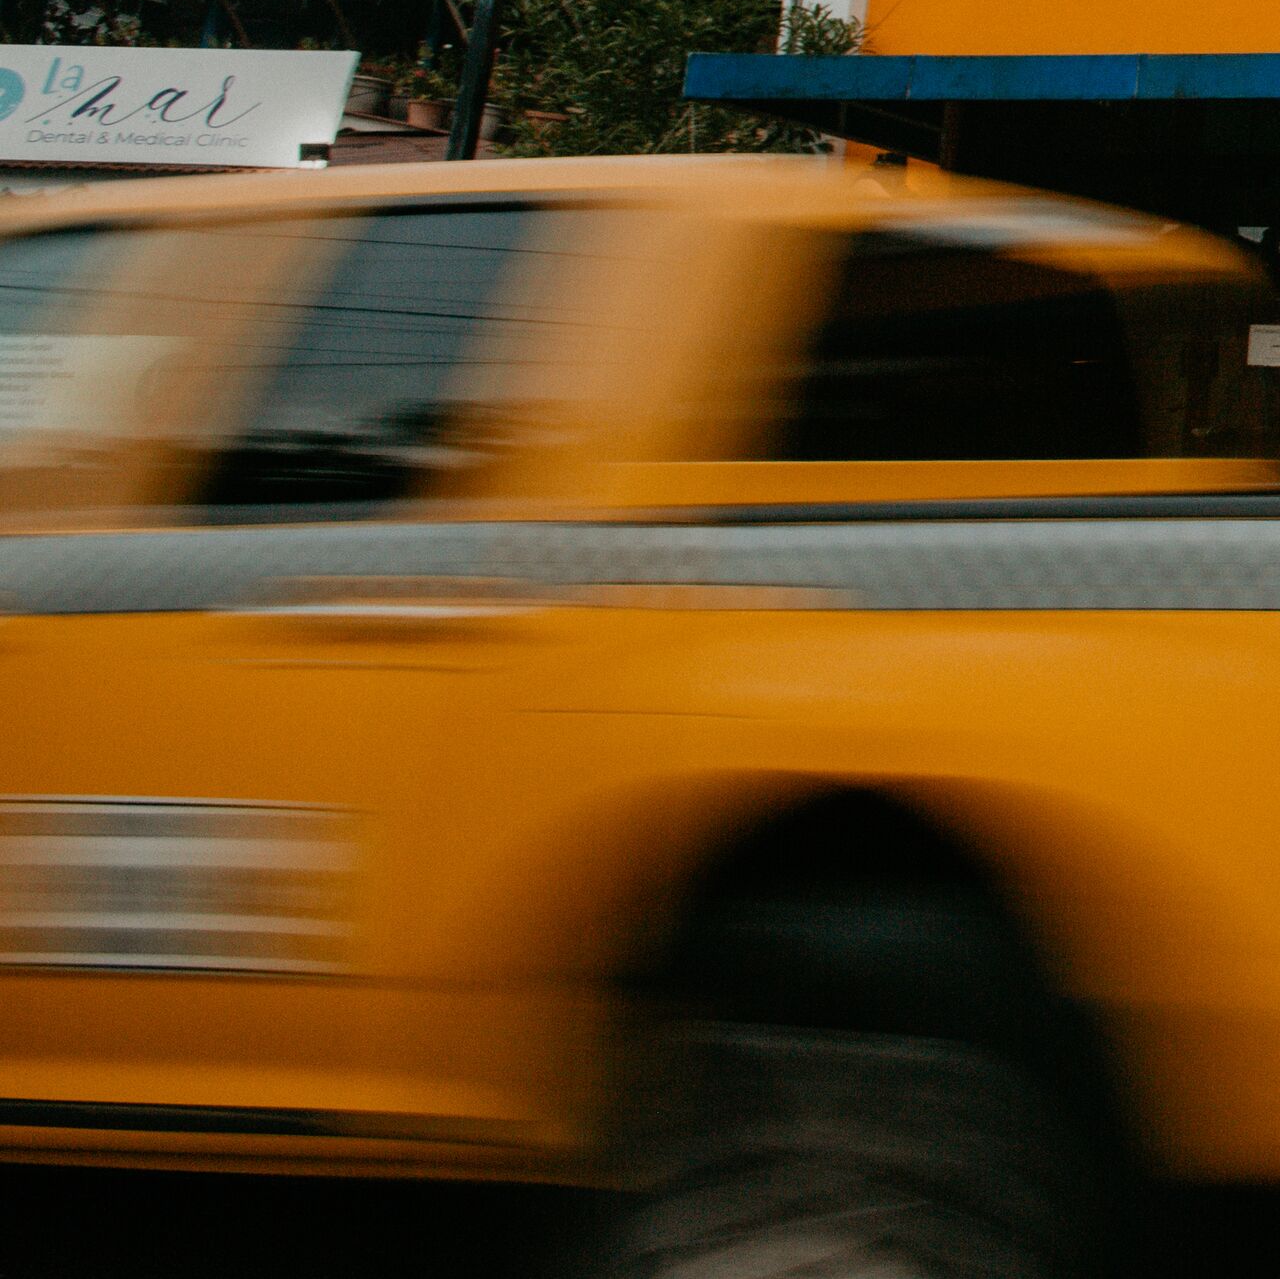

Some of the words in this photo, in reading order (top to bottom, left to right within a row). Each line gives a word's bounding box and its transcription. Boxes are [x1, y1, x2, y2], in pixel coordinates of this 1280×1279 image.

[26, 129, 92, 144] Dental
[97, 131, 108, 145] &
[114, 131, 191, 146] Medical
[196, 133, 249, 147] Clinic
